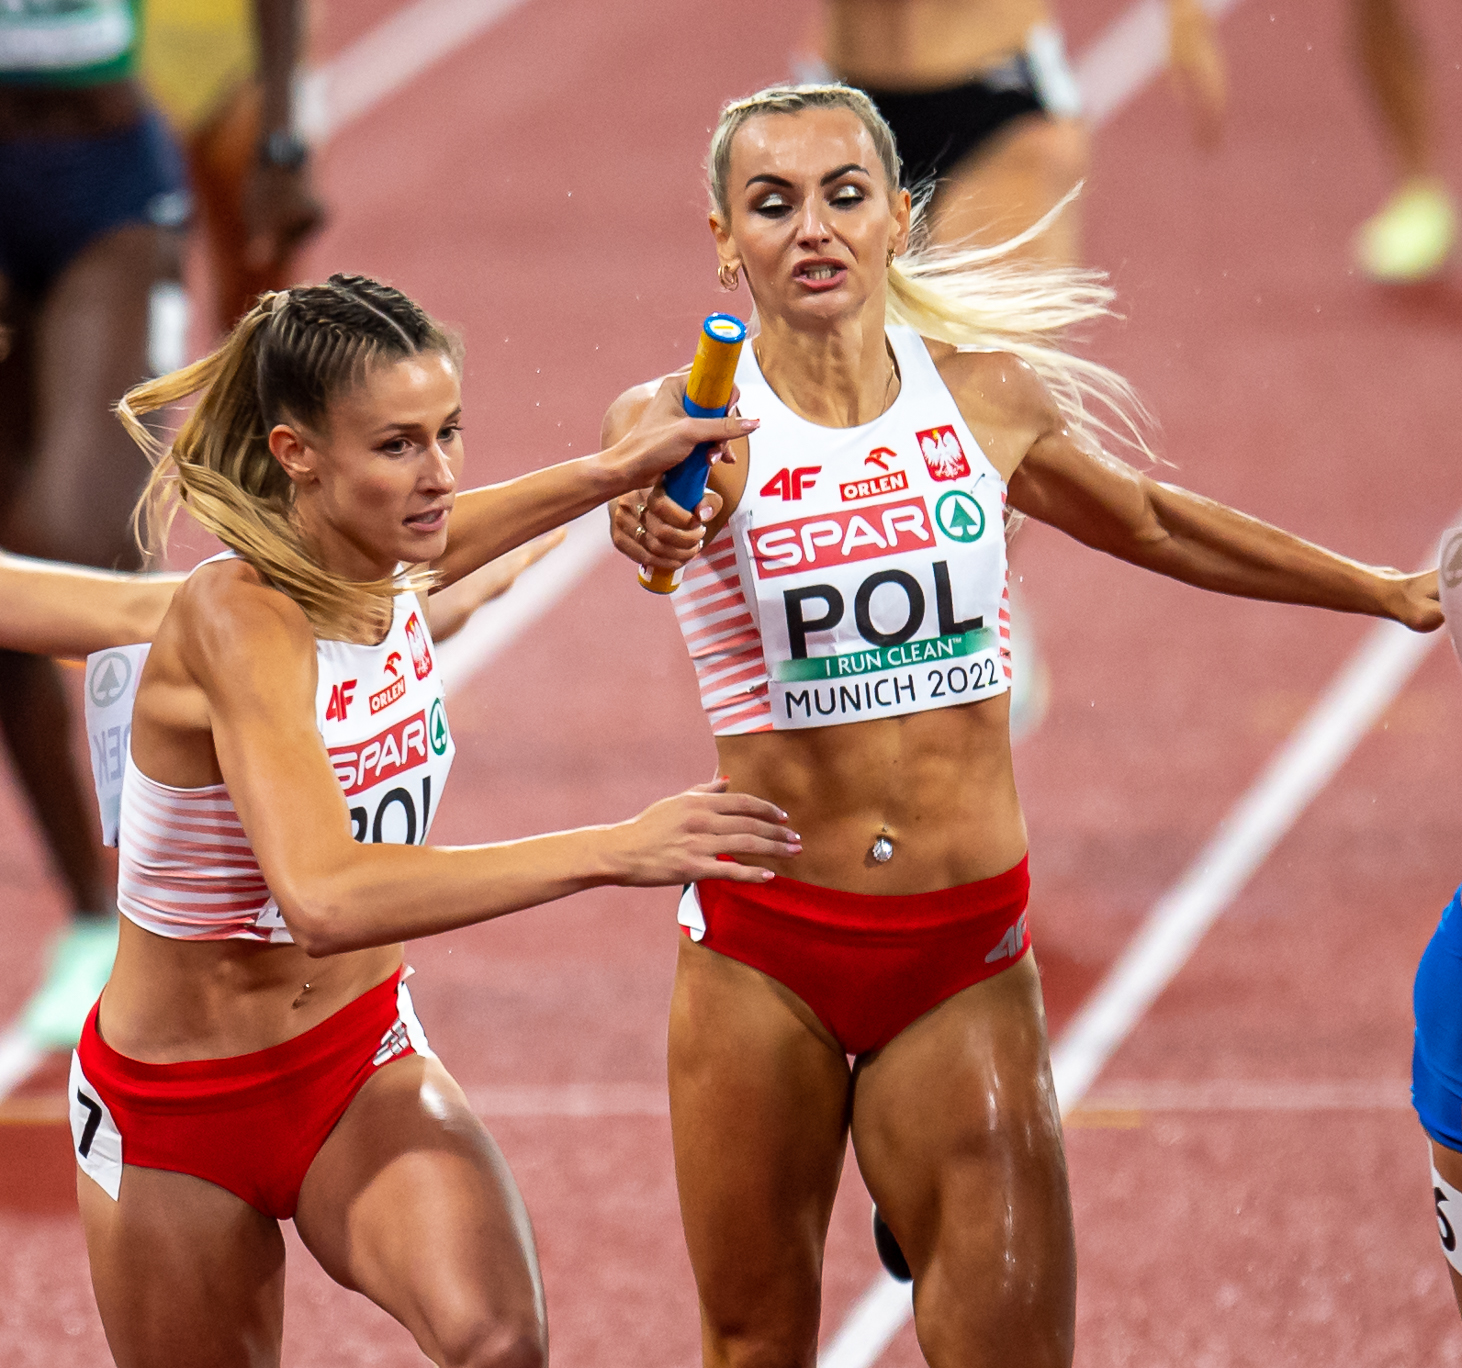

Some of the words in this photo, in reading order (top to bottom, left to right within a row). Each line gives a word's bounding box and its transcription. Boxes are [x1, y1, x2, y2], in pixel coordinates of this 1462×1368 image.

[759, 465, 822, 501] 4F
[843, 473, 904, 499] ORLEN
[757, 504, 930, 571] SPAR
[783, 559, 984, 660] POL
[784, 673, 916, 719] MUNICH
[927, 657, 999, 699] 2022
[825, 659, 831, 677] I
[838, 652, 882, 675] RUN
[325, 678, 358, 722] 4F
[371, 678, 405, 711] ORLEN
[328, 718, 426, 790] SPAR
[77, 1085, 103, 1160] 7
